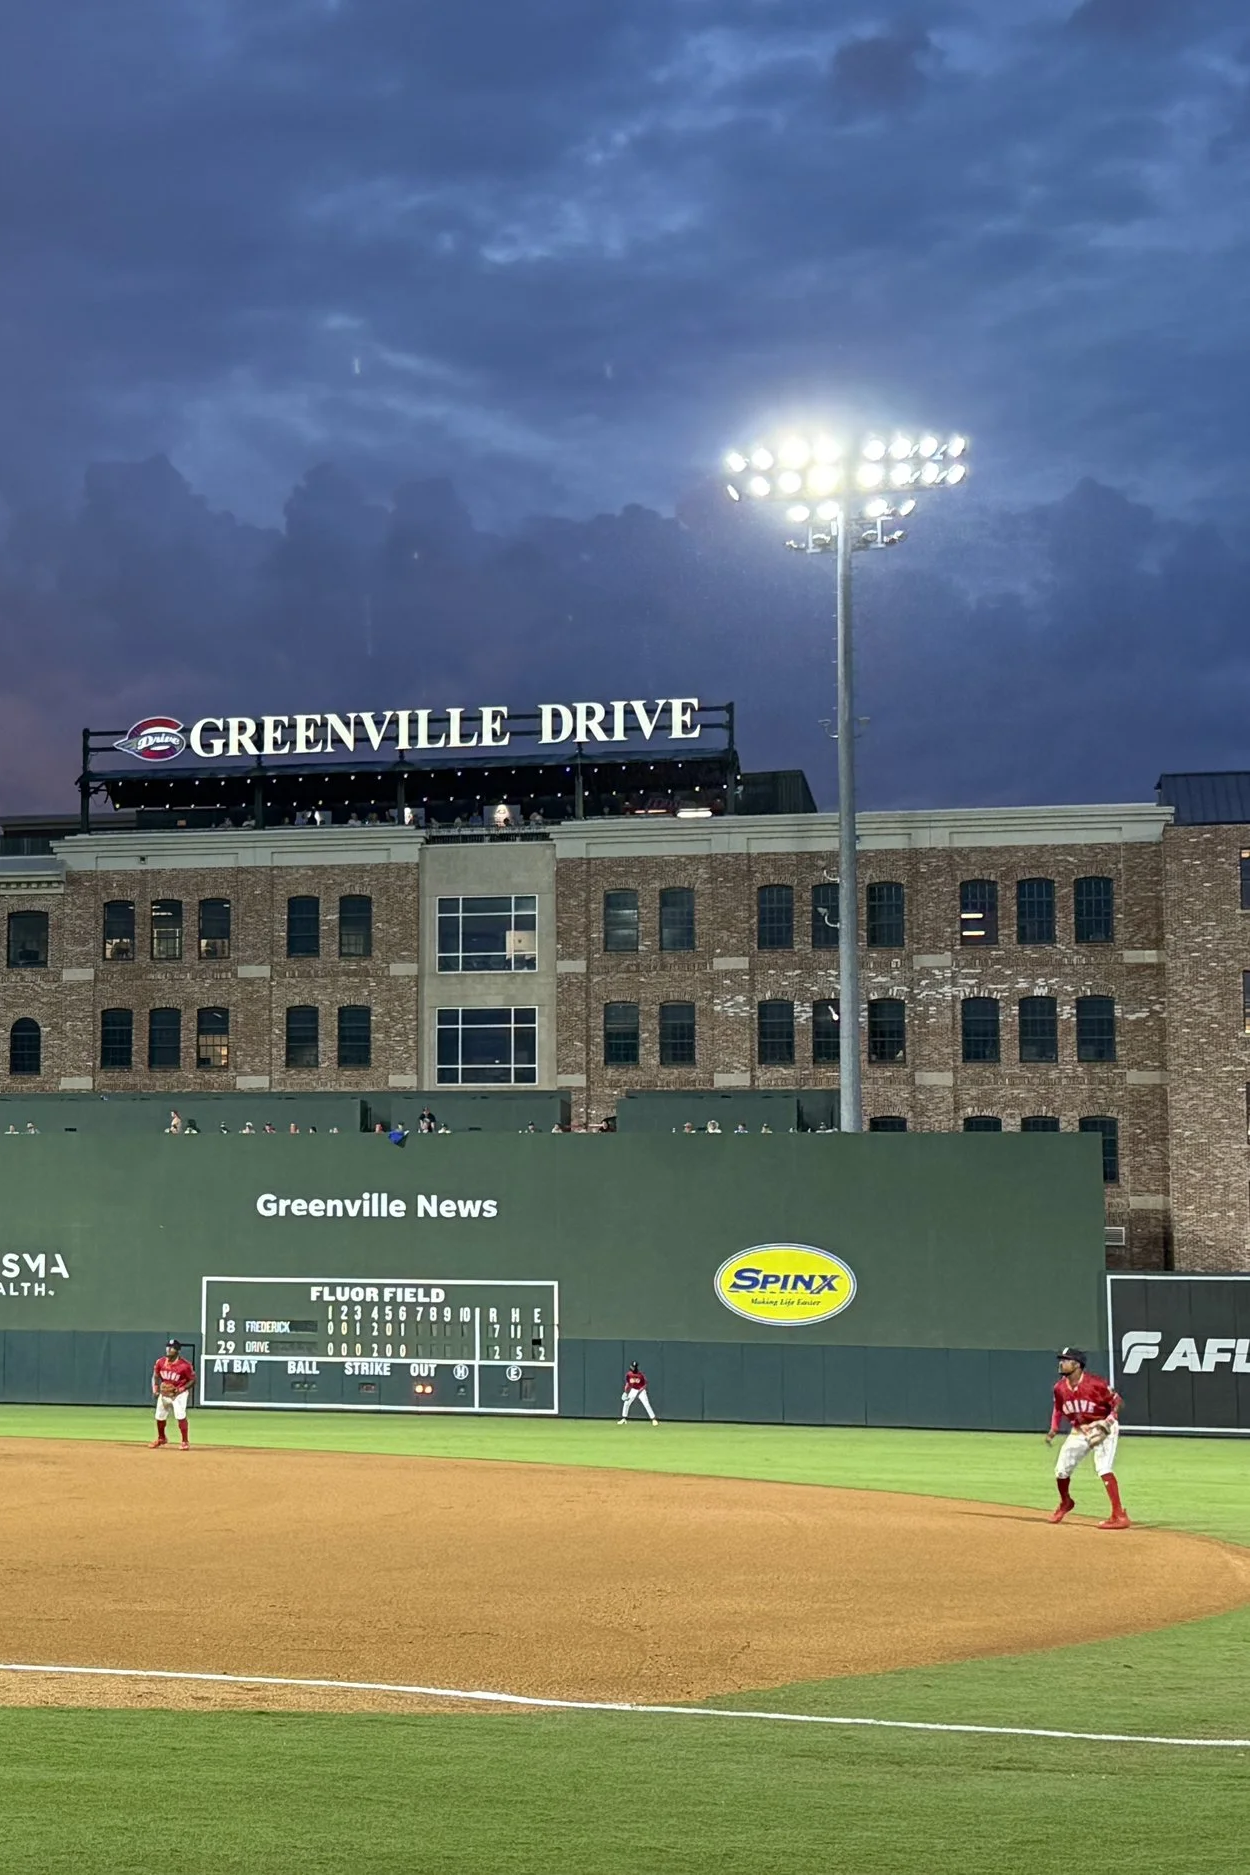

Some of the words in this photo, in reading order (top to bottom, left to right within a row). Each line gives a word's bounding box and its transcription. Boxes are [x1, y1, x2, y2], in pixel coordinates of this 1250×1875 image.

[189, 706, 510, 758] GREENVILLE
[538, 698, 700, 744] DRIVE
[137, 733, 180, 750] Drive
[256, 1192, 406, 1217] Greenville
[417, 1194, 498, 1218] News
[310, 1286, 379, 1302] FLUOR
[383, 1287, 446, 1303] FIELD
[222, 1303, 230, 1318] P
[328, 1305, 333, 1320] 1
[340, 1305, 348, 1320] 2
[354, 1305, 362, 1320] 3
[370, 1306, 379, 1320] 4
[384, 1306, 392, 1320] 5
[398, 1306, 407, 1321] 6
[416, 1306, 424, 1321] 7
[429, 1307, 438, 1321] 8
[443, 1307, 451, 1321] 9
[459, 1307, 471, 1322] 10
[489, 1307, 498, 1322] R
[511, 1308, 520, 1323] H
[533, 1308, 541, 1323] E
[219, 1319, 236, 1333] 18
[245, 1321, 291, 1333] FREDERICK
[327, 1322, 334, 1335] 0
[341, 1323, 348, 1335] 0
[372, 1323, 378, 1336] 2
[385, 1323, 392, 1336] 0
[493, 1324, 500, 1338] 7
[510, 1325, 522, 1338] 11
[217, 1341, 236, 1354] 29
[245, 1341, 270, 1353] DRIVE
[327, 1343, 334, 1356] 0
[341, 1343, 348, 1356] 0
[355, 1343, 362, 1356] 0
[372, 1344, 378, 1357] 2
[385, 1344, 392, 1357] 0
[399, 1344, 407, 1357] 0
[493, 1346, 500, 1359] 2
[515, 1346, 523, 1360] 5
[539, 1346, 545, 1360] 2
[213, 1359, 232, 1373] AT
[233, 1360, 258, 1373] BAT
[287, 1361, 320, 1374] BALL
[344, 1362, 391, 1376] STRIKE
[410, 1363, 437, 1376] OUT
